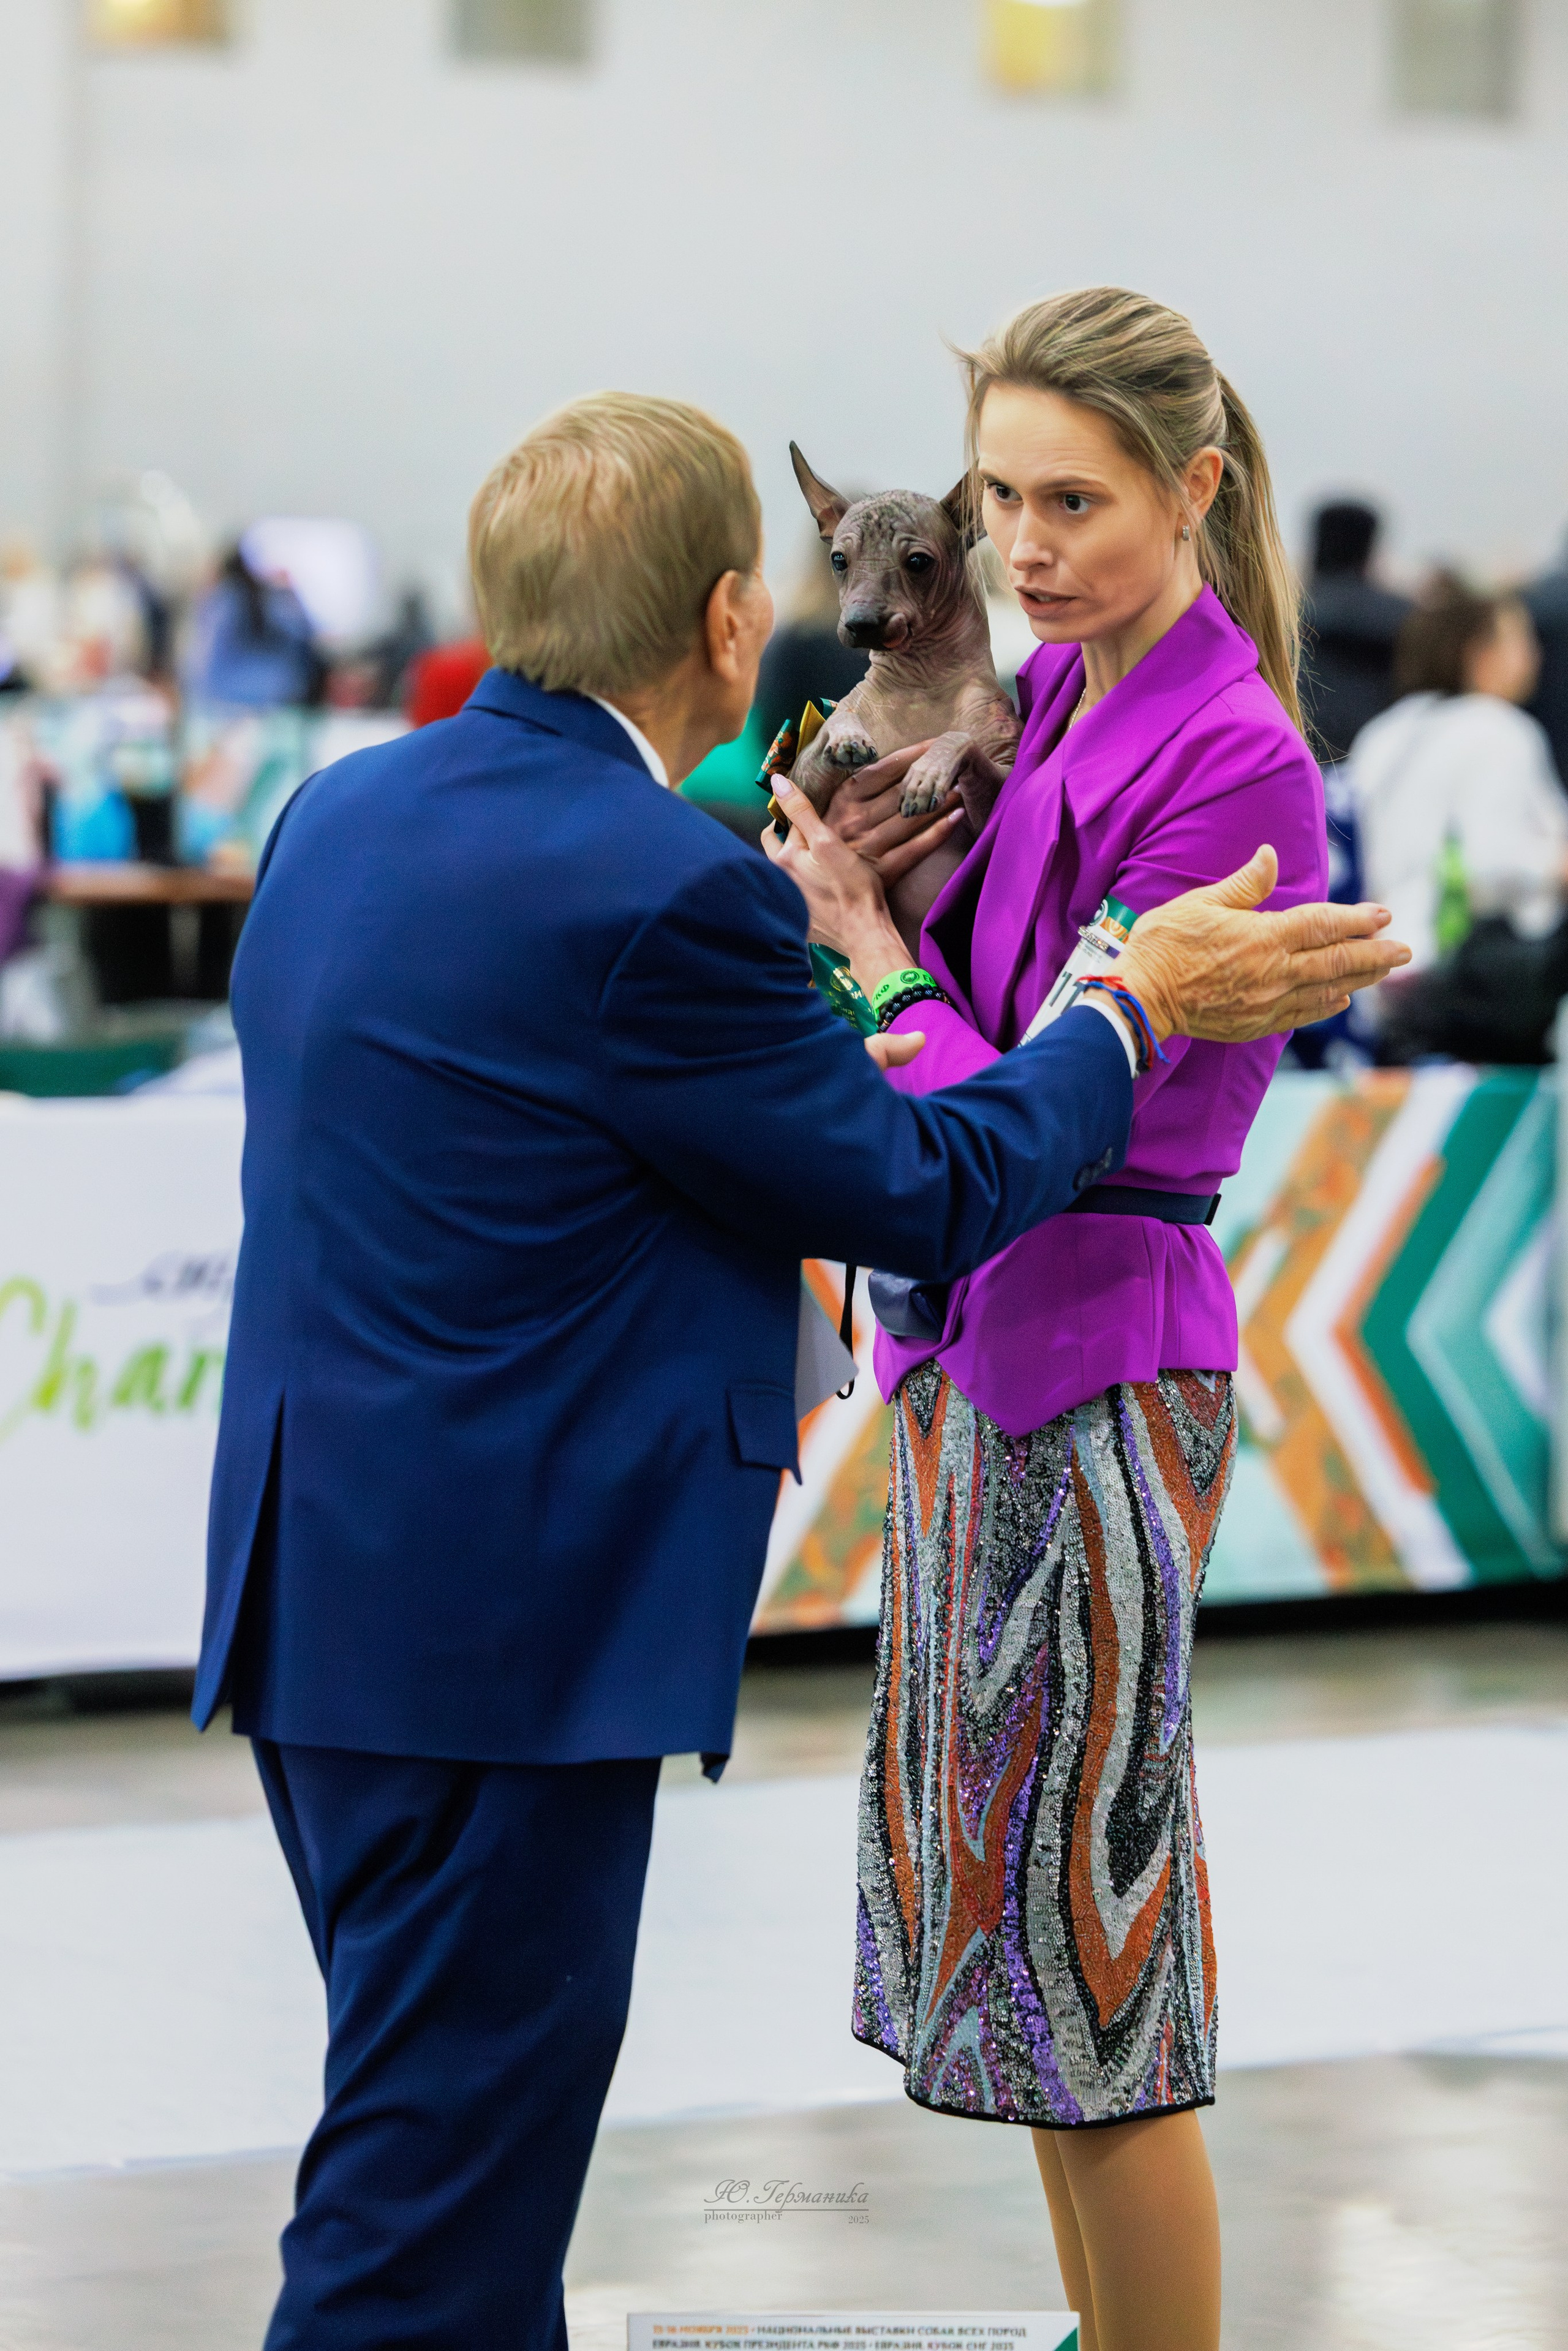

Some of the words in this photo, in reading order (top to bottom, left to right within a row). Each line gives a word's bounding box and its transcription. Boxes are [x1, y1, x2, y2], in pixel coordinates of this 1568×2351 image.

[855, 2326, 915, 2336] ВЫСТАВКИ
[918, 2326, 954, 2336] СОБАК
[957, 2326, 984, 2336] ВСЕХ
[987, 2326, 1027, 2337] ПОРОД
[744, 2340, 815, 2350] ПРЕЗИДЕНТА
